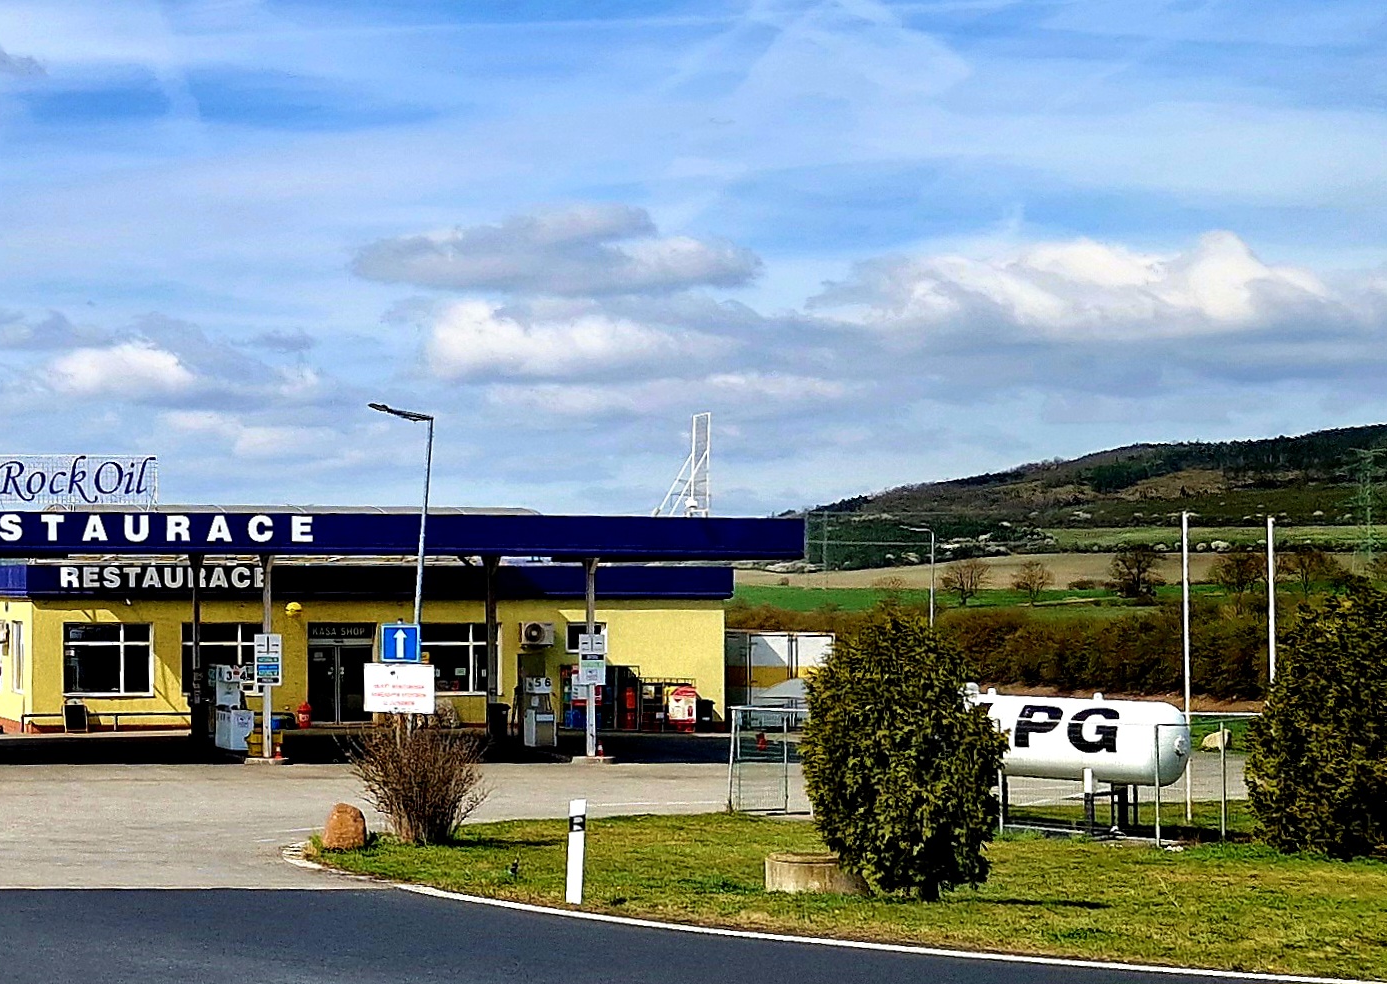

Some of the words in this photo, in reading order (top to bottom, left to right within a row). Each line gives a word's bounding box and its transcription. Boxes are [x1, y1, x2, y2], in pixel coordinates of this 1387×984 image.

[312, 627, 337, 636] KASA
[340, 627, 365, 636] SHOP
[226, 671, 233, 681] 3
[240, 671, 246, 681] 4
[535, 677, 541, 687] 5
[545, 677, 551, 687] 6
[979, 703, 1120, 753] PG
